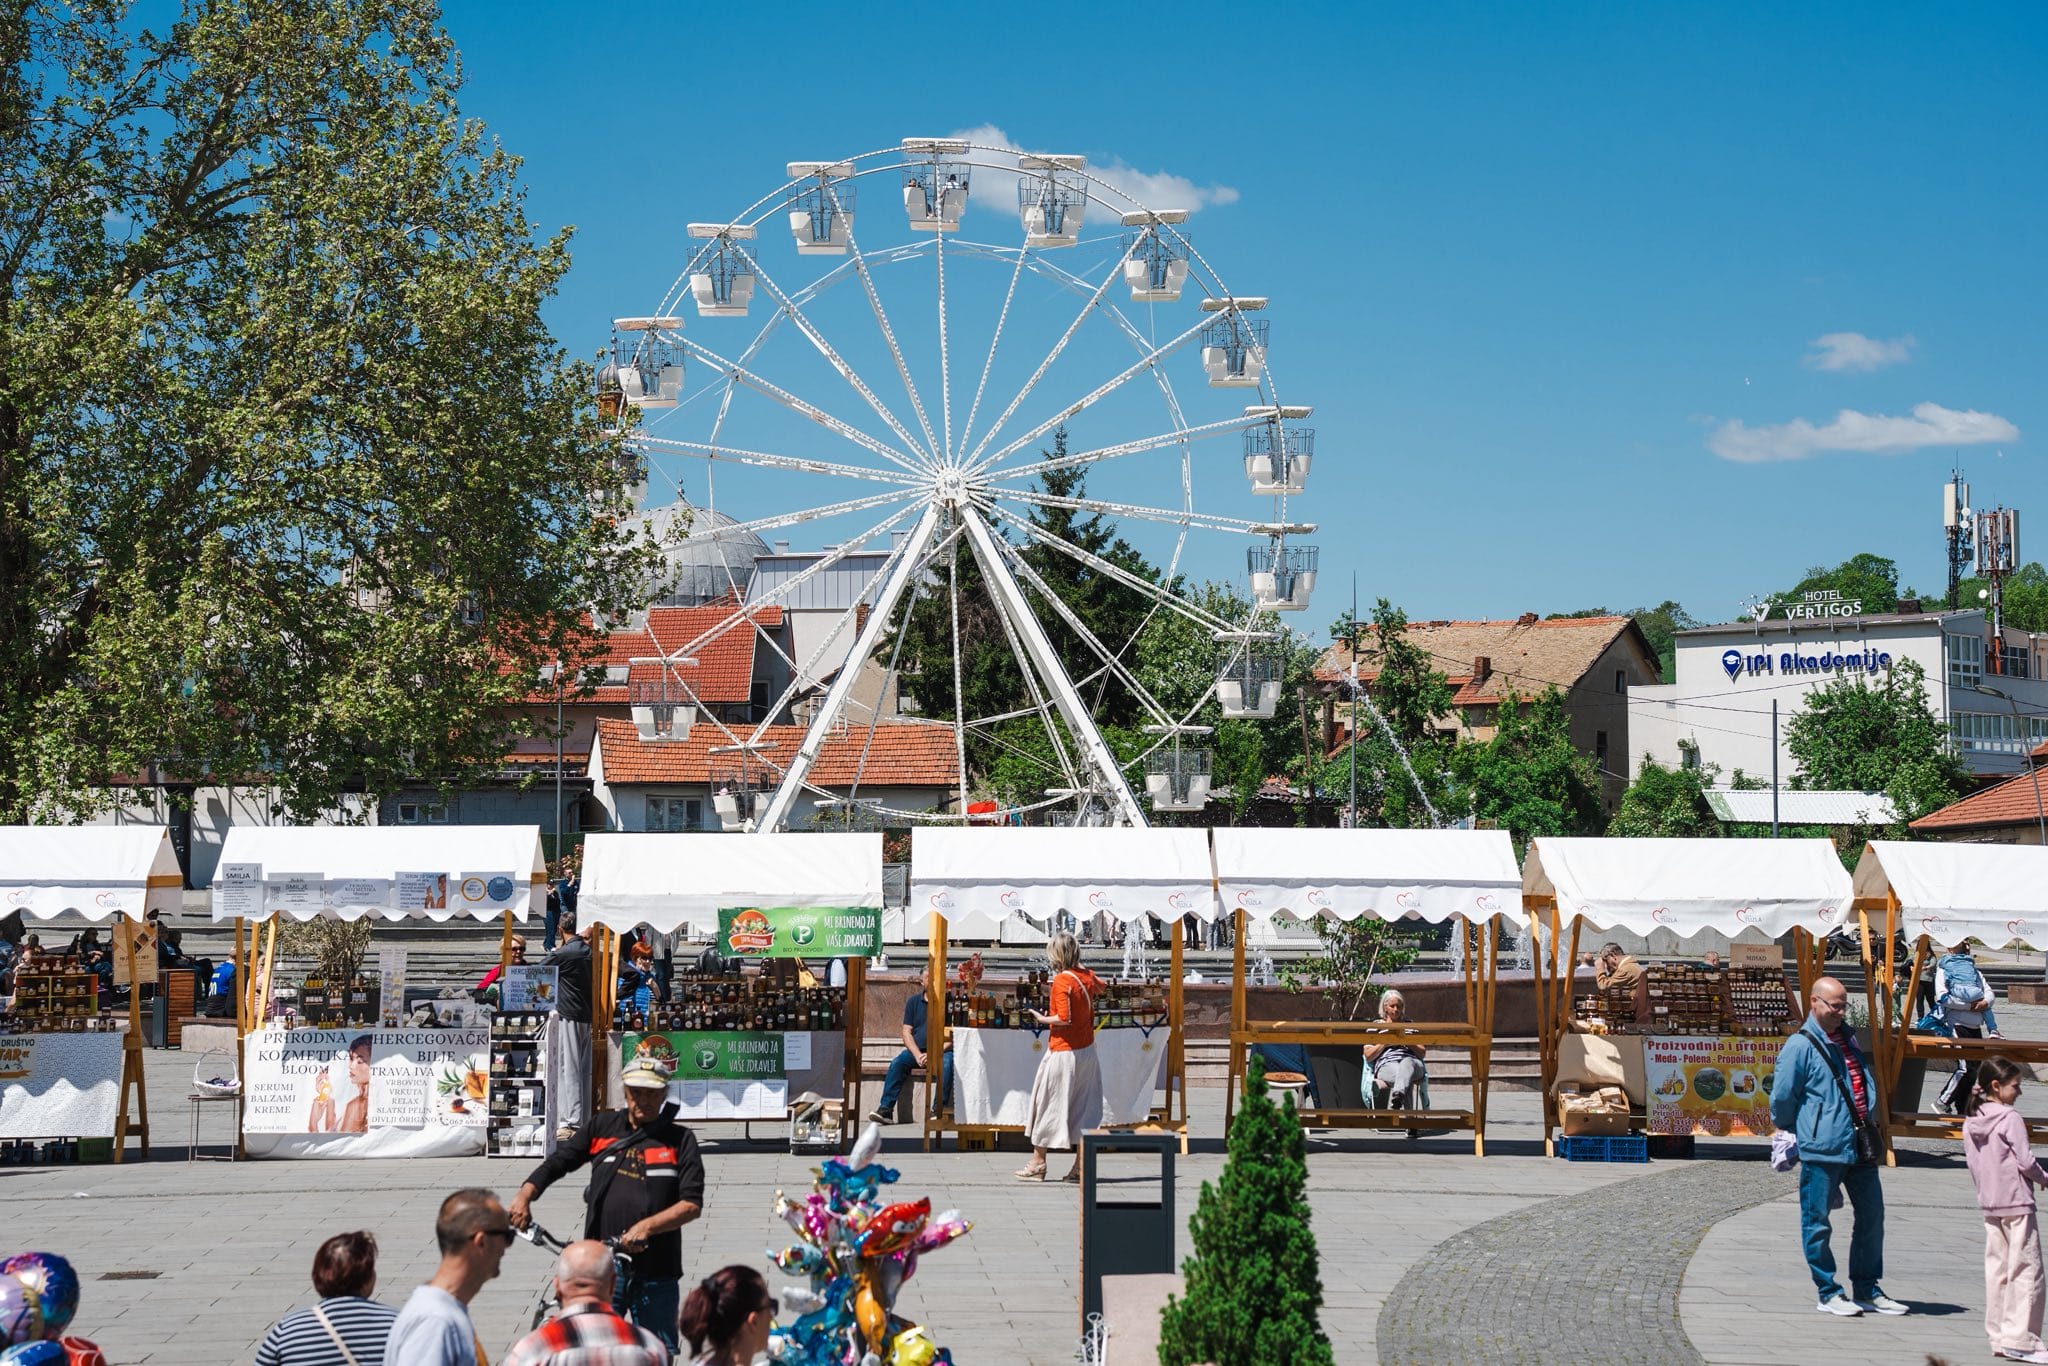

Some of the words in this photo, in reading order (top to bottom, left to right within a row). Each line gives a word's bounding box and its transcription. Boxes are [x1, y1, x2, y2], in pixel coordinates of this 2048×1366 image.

[1805, 590, 1843, 601] HOTEL
[1785, 601, 1862, 620] VERTIGOS
[1746, 654, 1772, 672] IPI
[1780, 648, 1891, 671] Akademije
[824, 915, 833, 928] MI
[835, 915, 866, 928] BRINEMO
[867, 915, 875, 928] ZA
[826, 930, 842, 947] VAŠE
[843, 934, 874, 948] ZDRAVLJE
[1, 1038, 35, 1047] DRUŠTVO
[264, 1032, 347, 1044] PRIRODNA
[727, 1041, 736, 1054] MI
[739, 1041, 769, 1054] BRINEMO
[770, 1041, 778, 1053] ZA
[1647, 1041, 1725, 1052] Proizvodnja
[258, 1050, 350, 1061] KOZMETIKA
[417, 1051, 455, 1064] BILJE
[1655, 1054, 1677, 1063] Meda
[1683, 1055, 1711, 1063] Polena
[1718, 1055, 1756, 1065] Propolisa
[282, 1065, 329, 1075] BLOOM
[729, 1056, 745, 1072] VAŠE
[746, 1060, 776, 1073] ZDRAVLJE
[370, 1067, 410, 1076] TRAVA
[415, 1067, 435, 1076] IVA
[254, 1083, 294, 1091] SERUMI
[251, 1095, 296, 1103] BALZAMI
[254, 1106, 291, 1114] KREME
